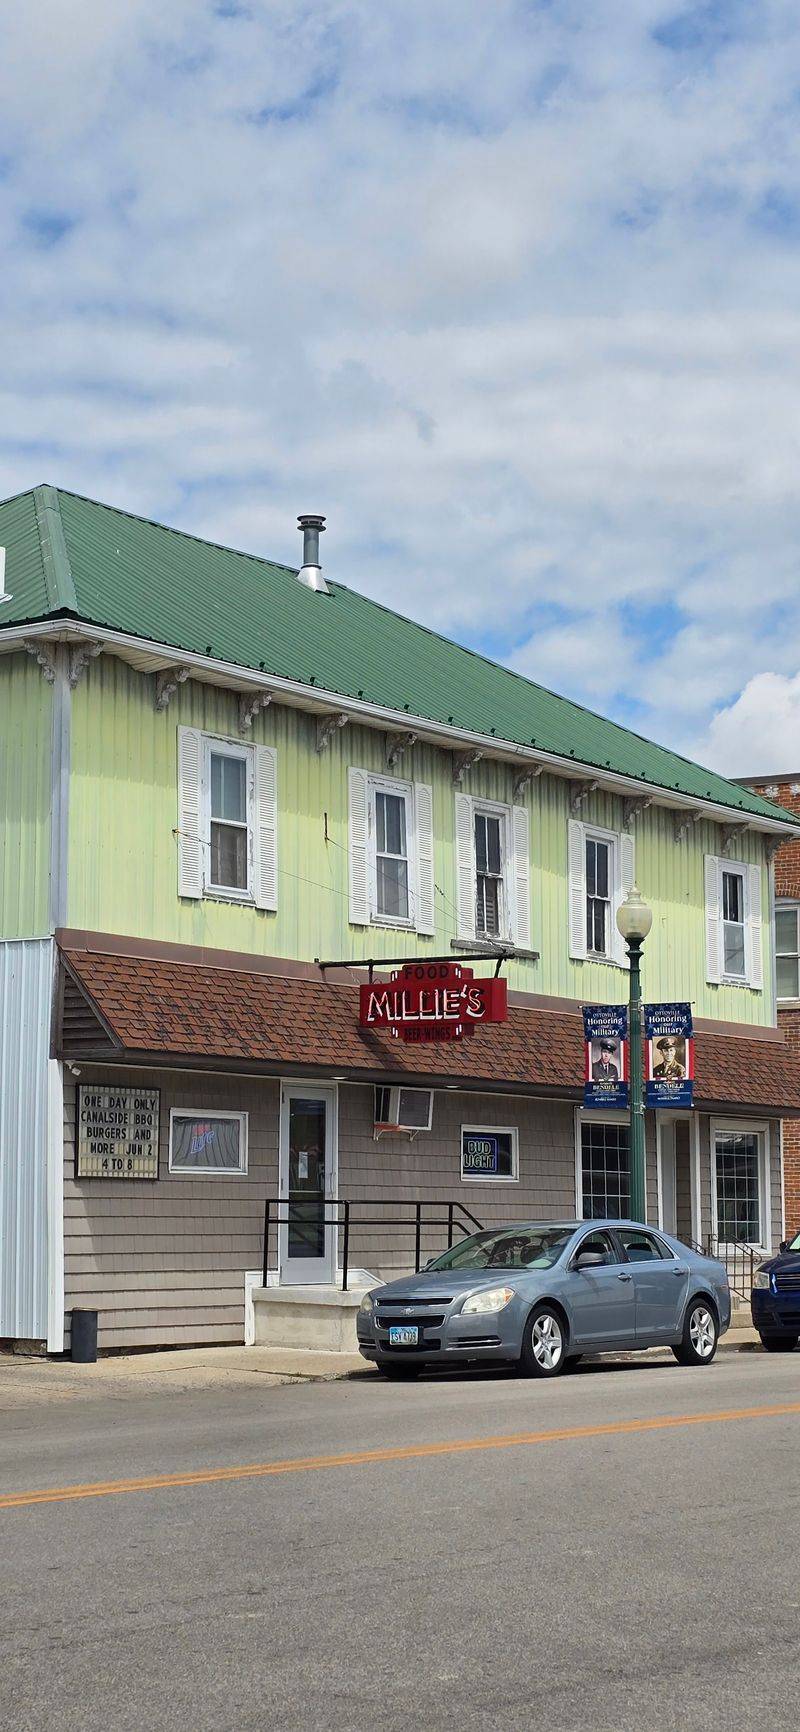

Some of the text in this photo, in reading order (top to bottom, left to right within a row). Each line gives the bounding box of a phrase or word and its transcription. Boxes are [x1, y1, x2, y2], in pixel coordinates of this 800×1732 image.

[404, 966, 449, 980] FOOD
[367, 984, 486, 1021] MILLIE'S
[587, 1017, 623, 1026] Honoring
[649, 1014, 687, 1023] Honoring
[591, 1028, 619, 1036] Military
[653, 1026, 684, 1035] Military
[84, 1095, 156, 1111] ONE DAY ONLY
[81, 1110, 153, 1126] CANALSIDE BBQ
[86, 1126, 151, 1140] BURGERS AND
[90, 1142, 115, 1154] MORE
[147, 1144, 153, 1156] 2
[467, 1140, 492, 1155] BUD
[102, 1159, 133, 1171] 4 TO 8
[463, 1153, 495, 1168] LIGHT
